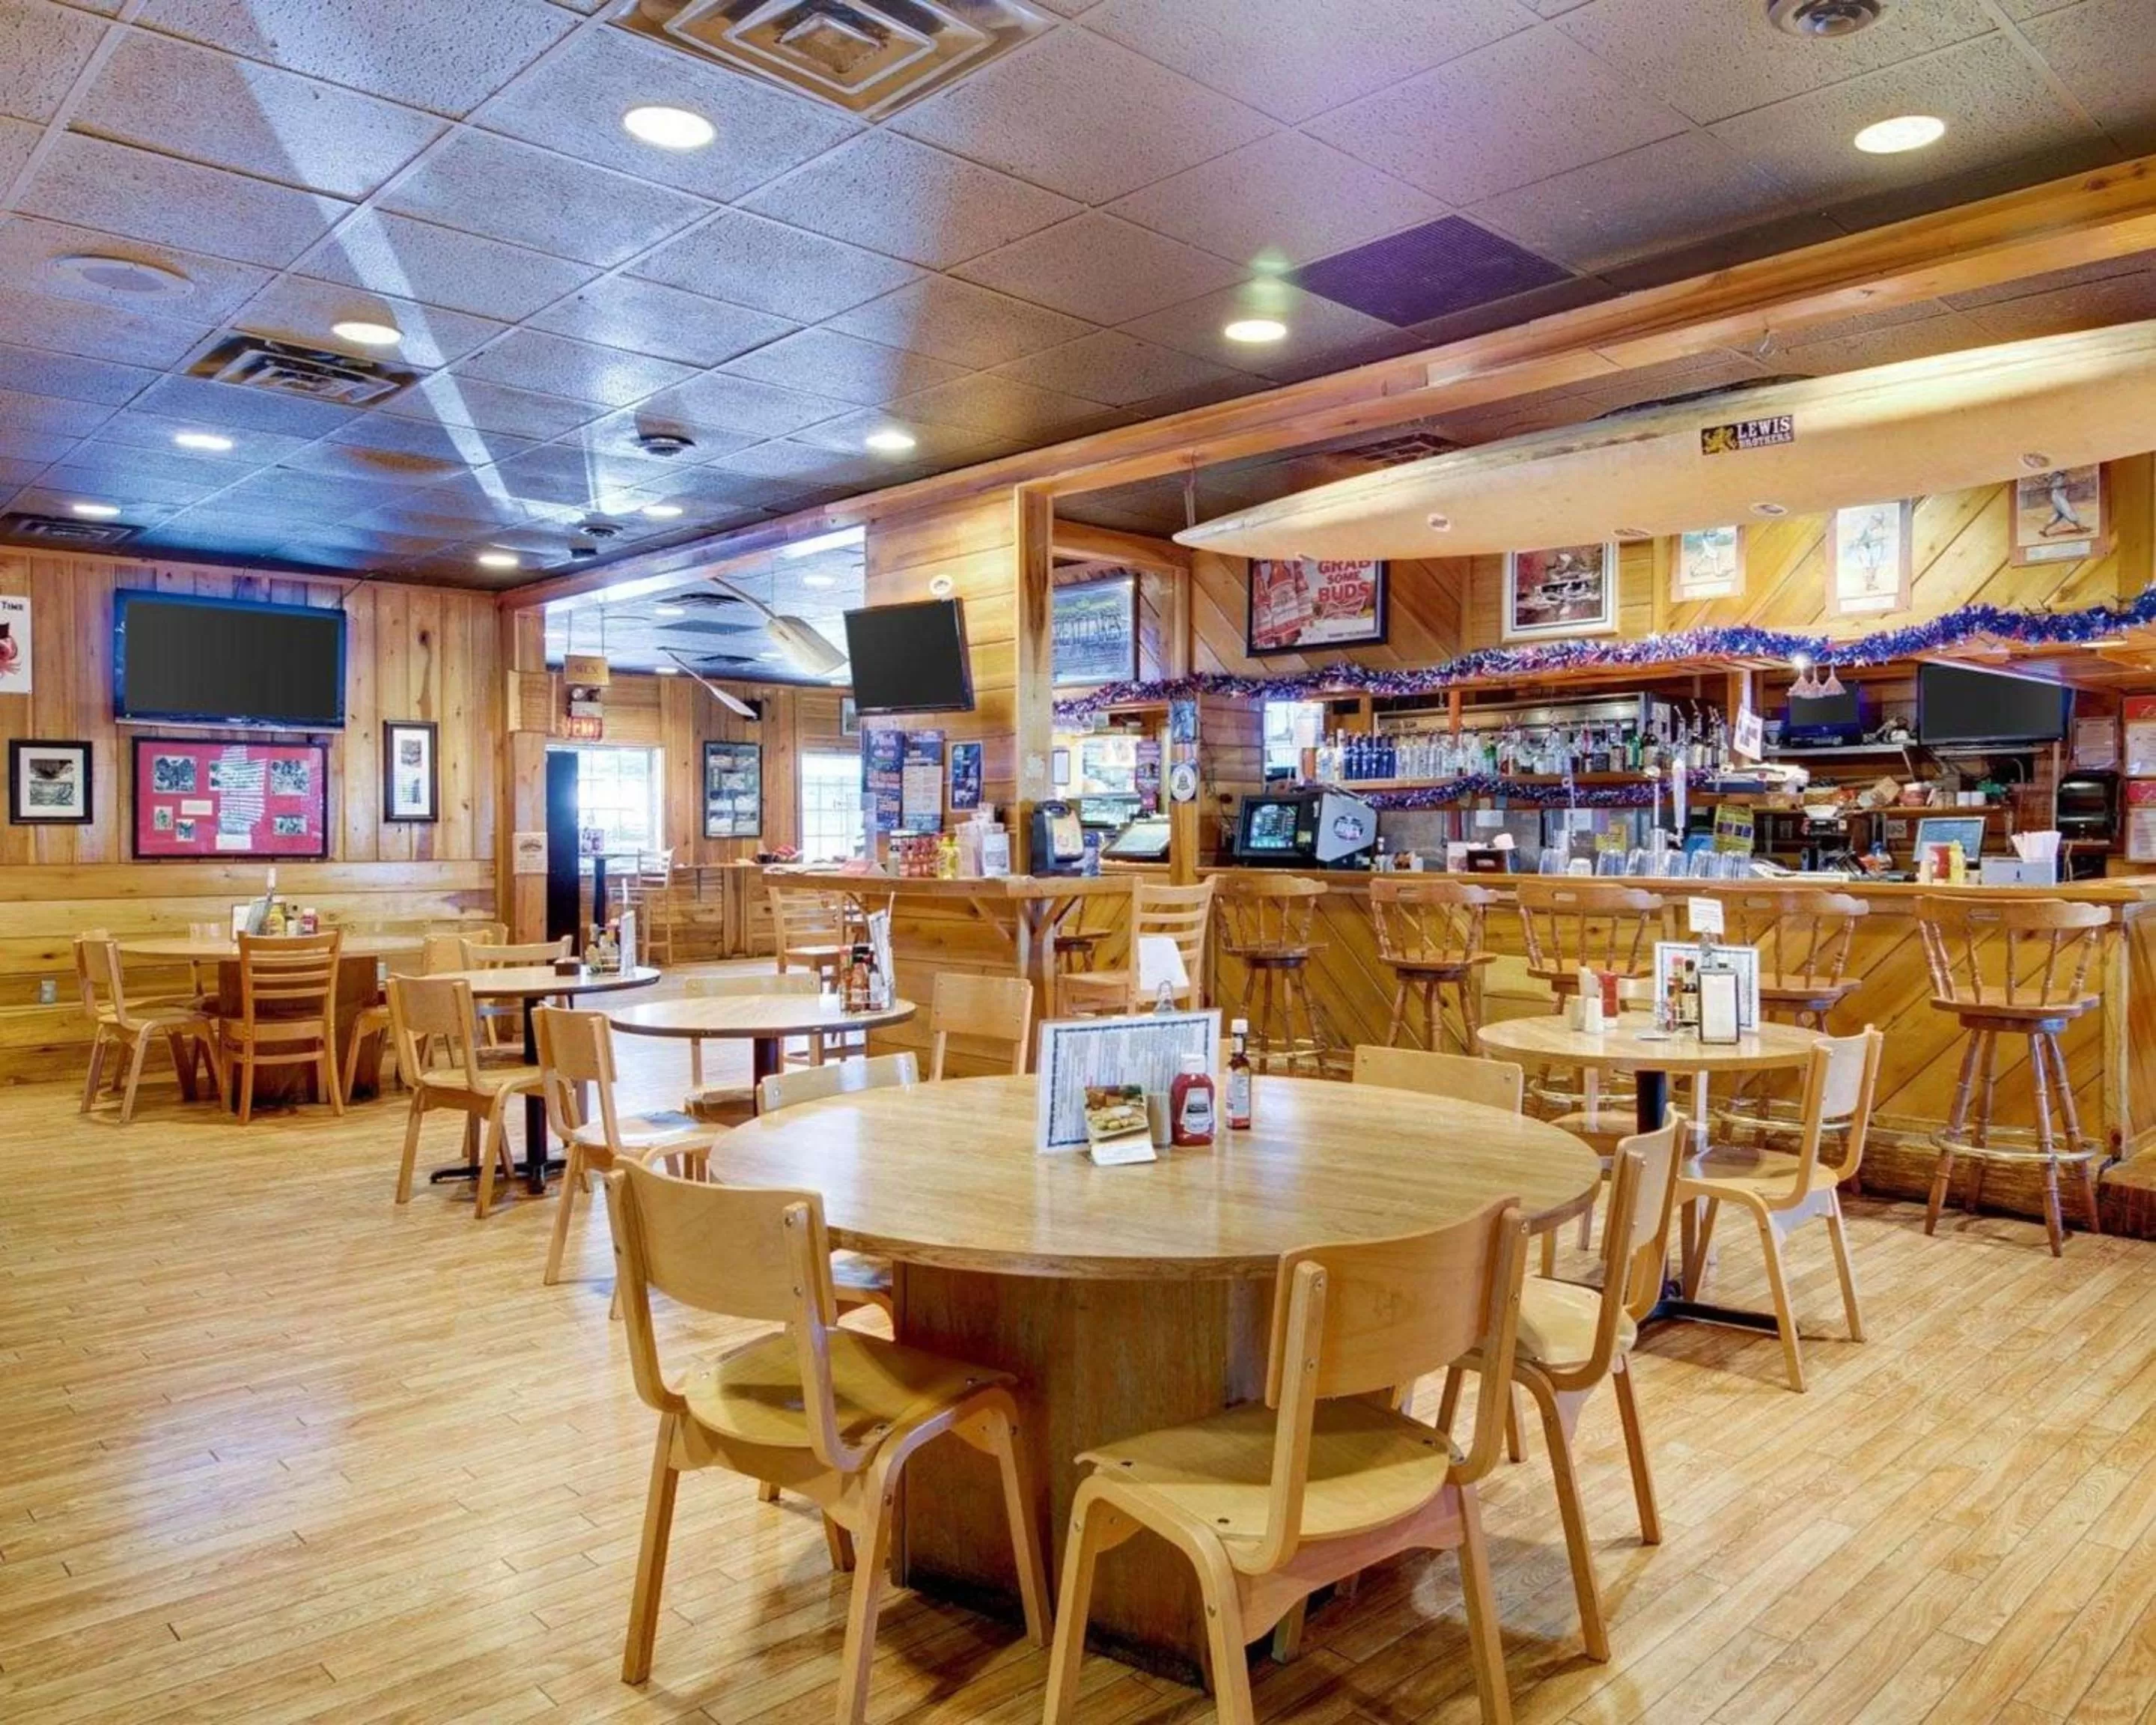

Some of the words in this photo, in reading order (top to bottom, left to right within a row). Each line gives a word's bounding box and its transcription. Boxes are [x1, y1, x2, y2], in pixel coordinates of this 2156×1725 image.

[1738, 416, 1790, 439] LEWIS
[1318, 560, 1371, 574] GRAB
[1327, 571, 1362, 585] SOME
[1318, 582, 1370, 602] BUDS
